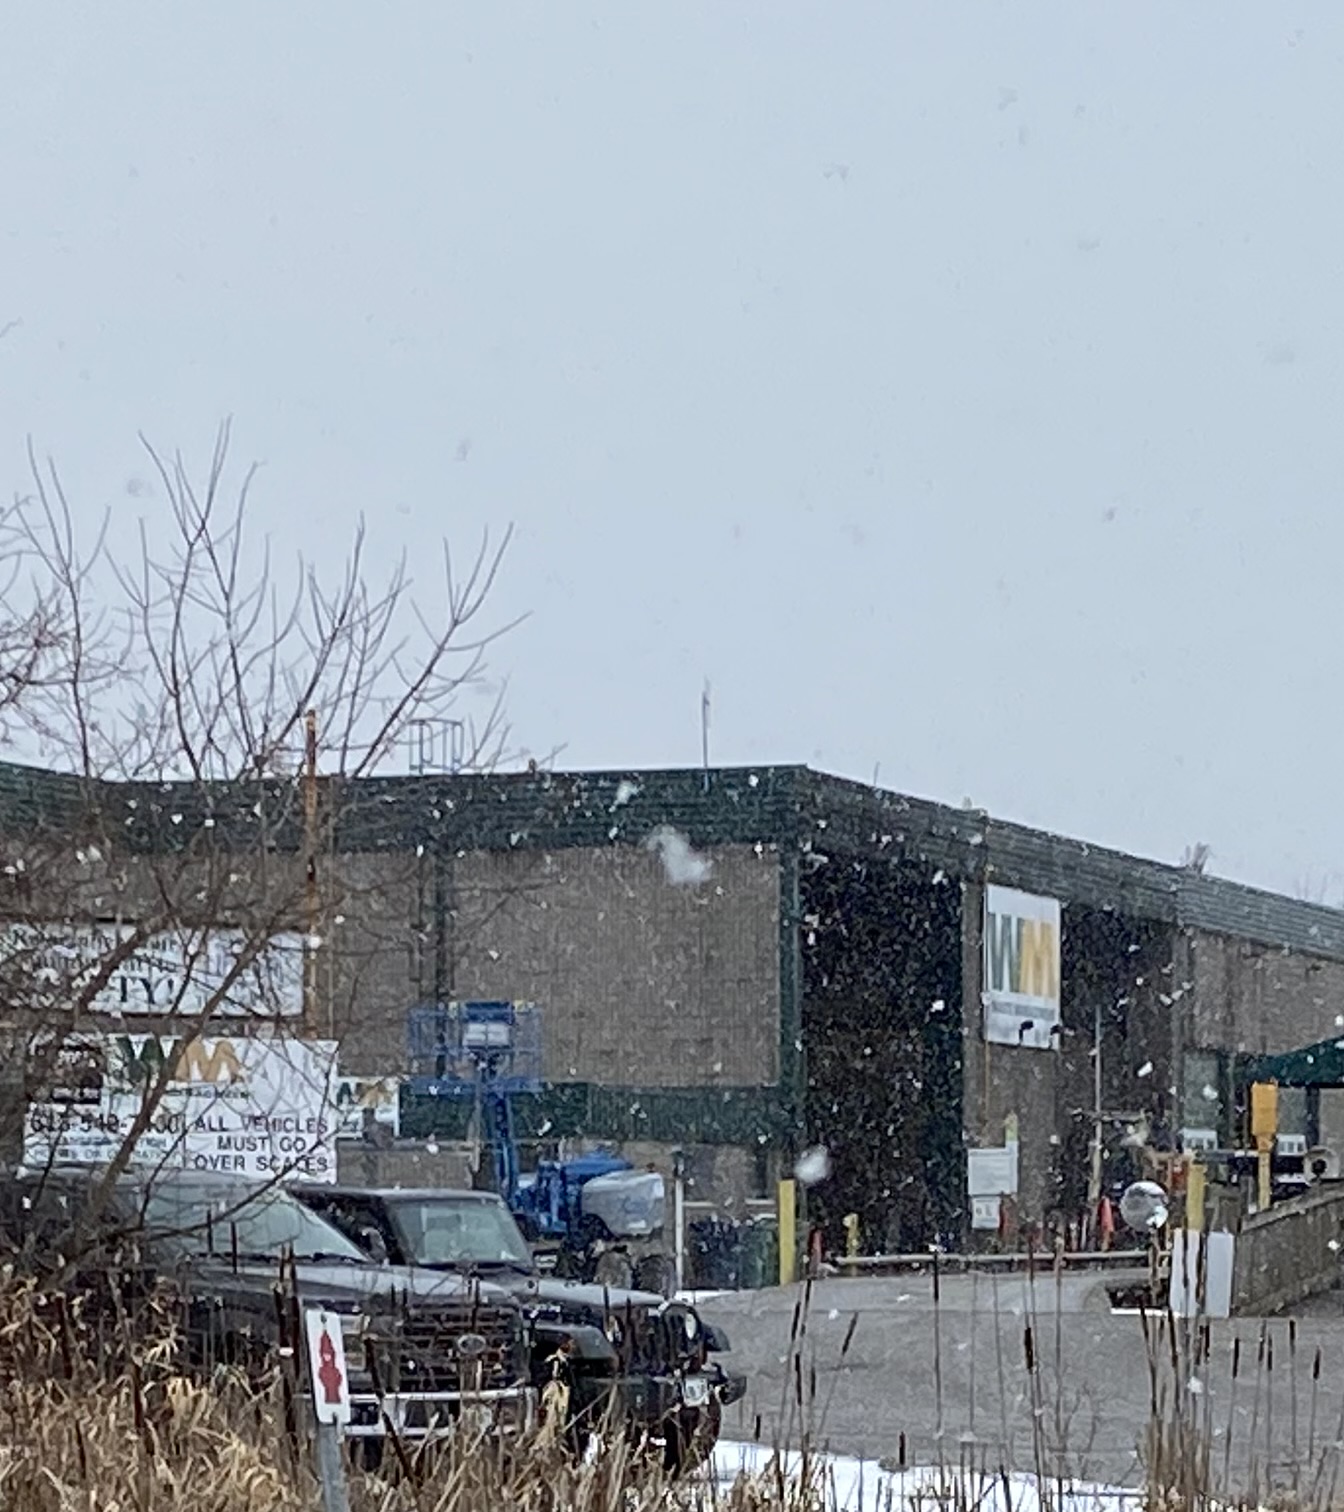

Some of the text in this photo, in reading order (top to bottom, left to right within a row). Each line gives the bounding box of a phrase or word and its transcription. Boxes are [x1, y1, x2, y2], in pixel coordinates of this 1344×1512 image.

[987, 912, 1055, 998] WM
[195, 1116, 229, 1132] ALL
[243, 1115, 328, 1133] VEHICLES
[217, 1136, 306, 1151] MUST GO
[194, 1154, 246, 1170] OVER
